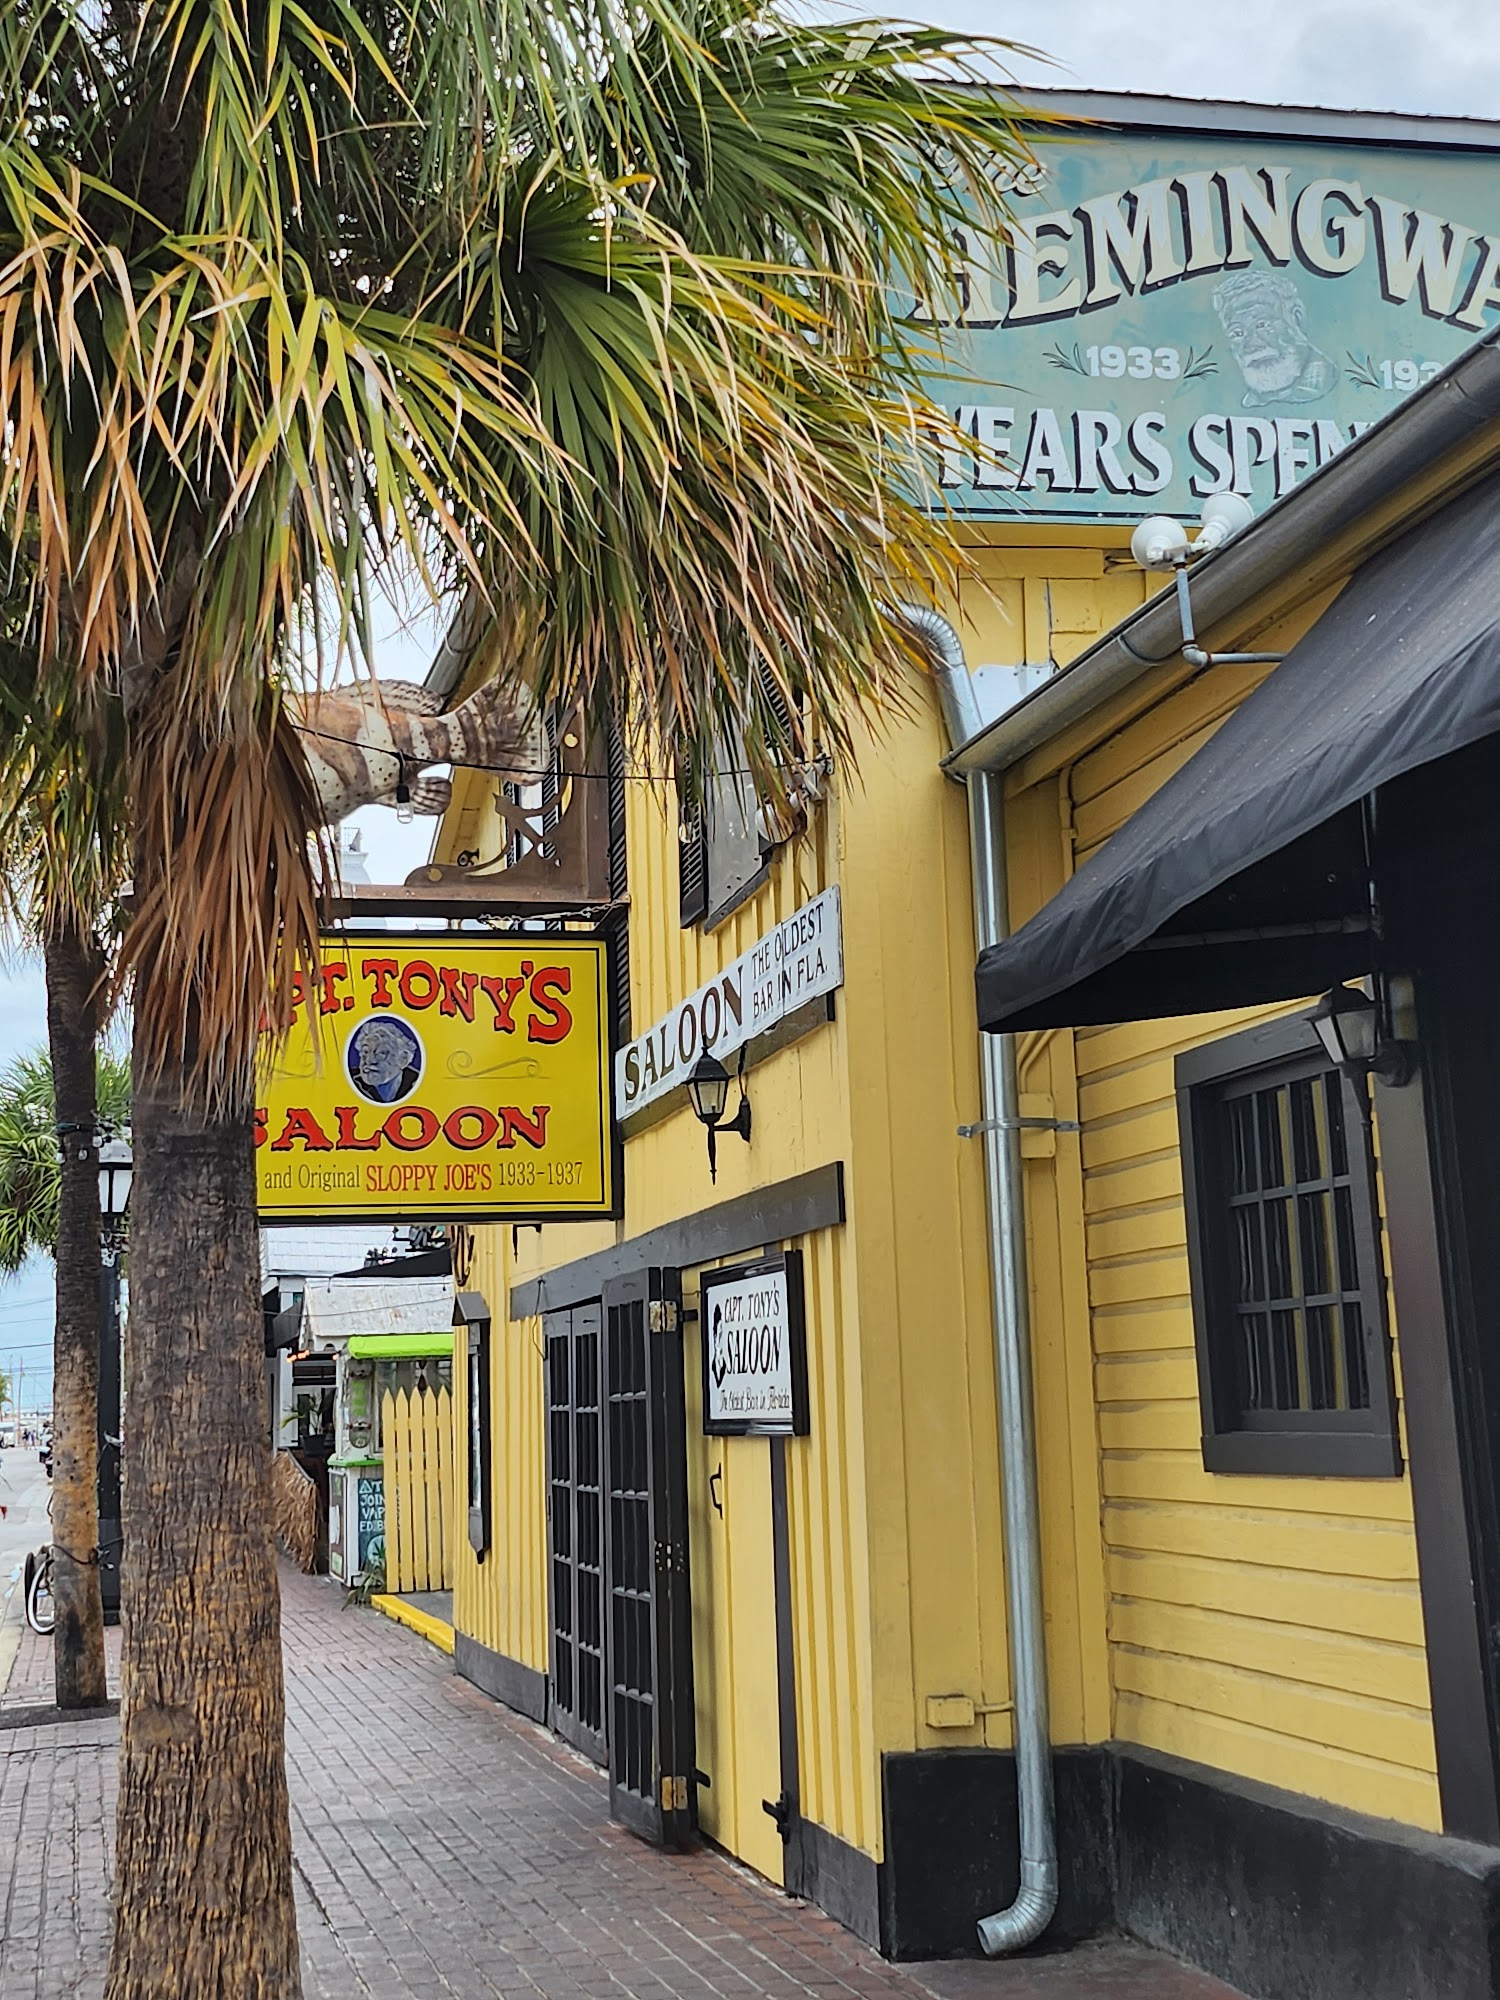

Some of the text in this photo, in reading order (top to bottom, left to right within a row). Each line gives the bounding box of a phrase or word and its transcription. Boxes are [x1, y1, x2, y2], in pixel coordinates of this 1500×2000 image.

[1087, 344, 1182, 380] 1933
[926, 405, 1174, 497] YEARS
[752, 902, 825, 981] THE OLDEST
[362, 959, 572, 1044] TONY'S
[753, 947, 828, 1019] BAR IN FLA.
[624, 964, 744, 1103] SALOON
[264, 1161, 583, 1192] and Original SLOPPY JOE'S 1933-1937
[724, 1280, 780, 1324] CAPT. TONY'S
[726, 1325, 781, 1375] SALOON
